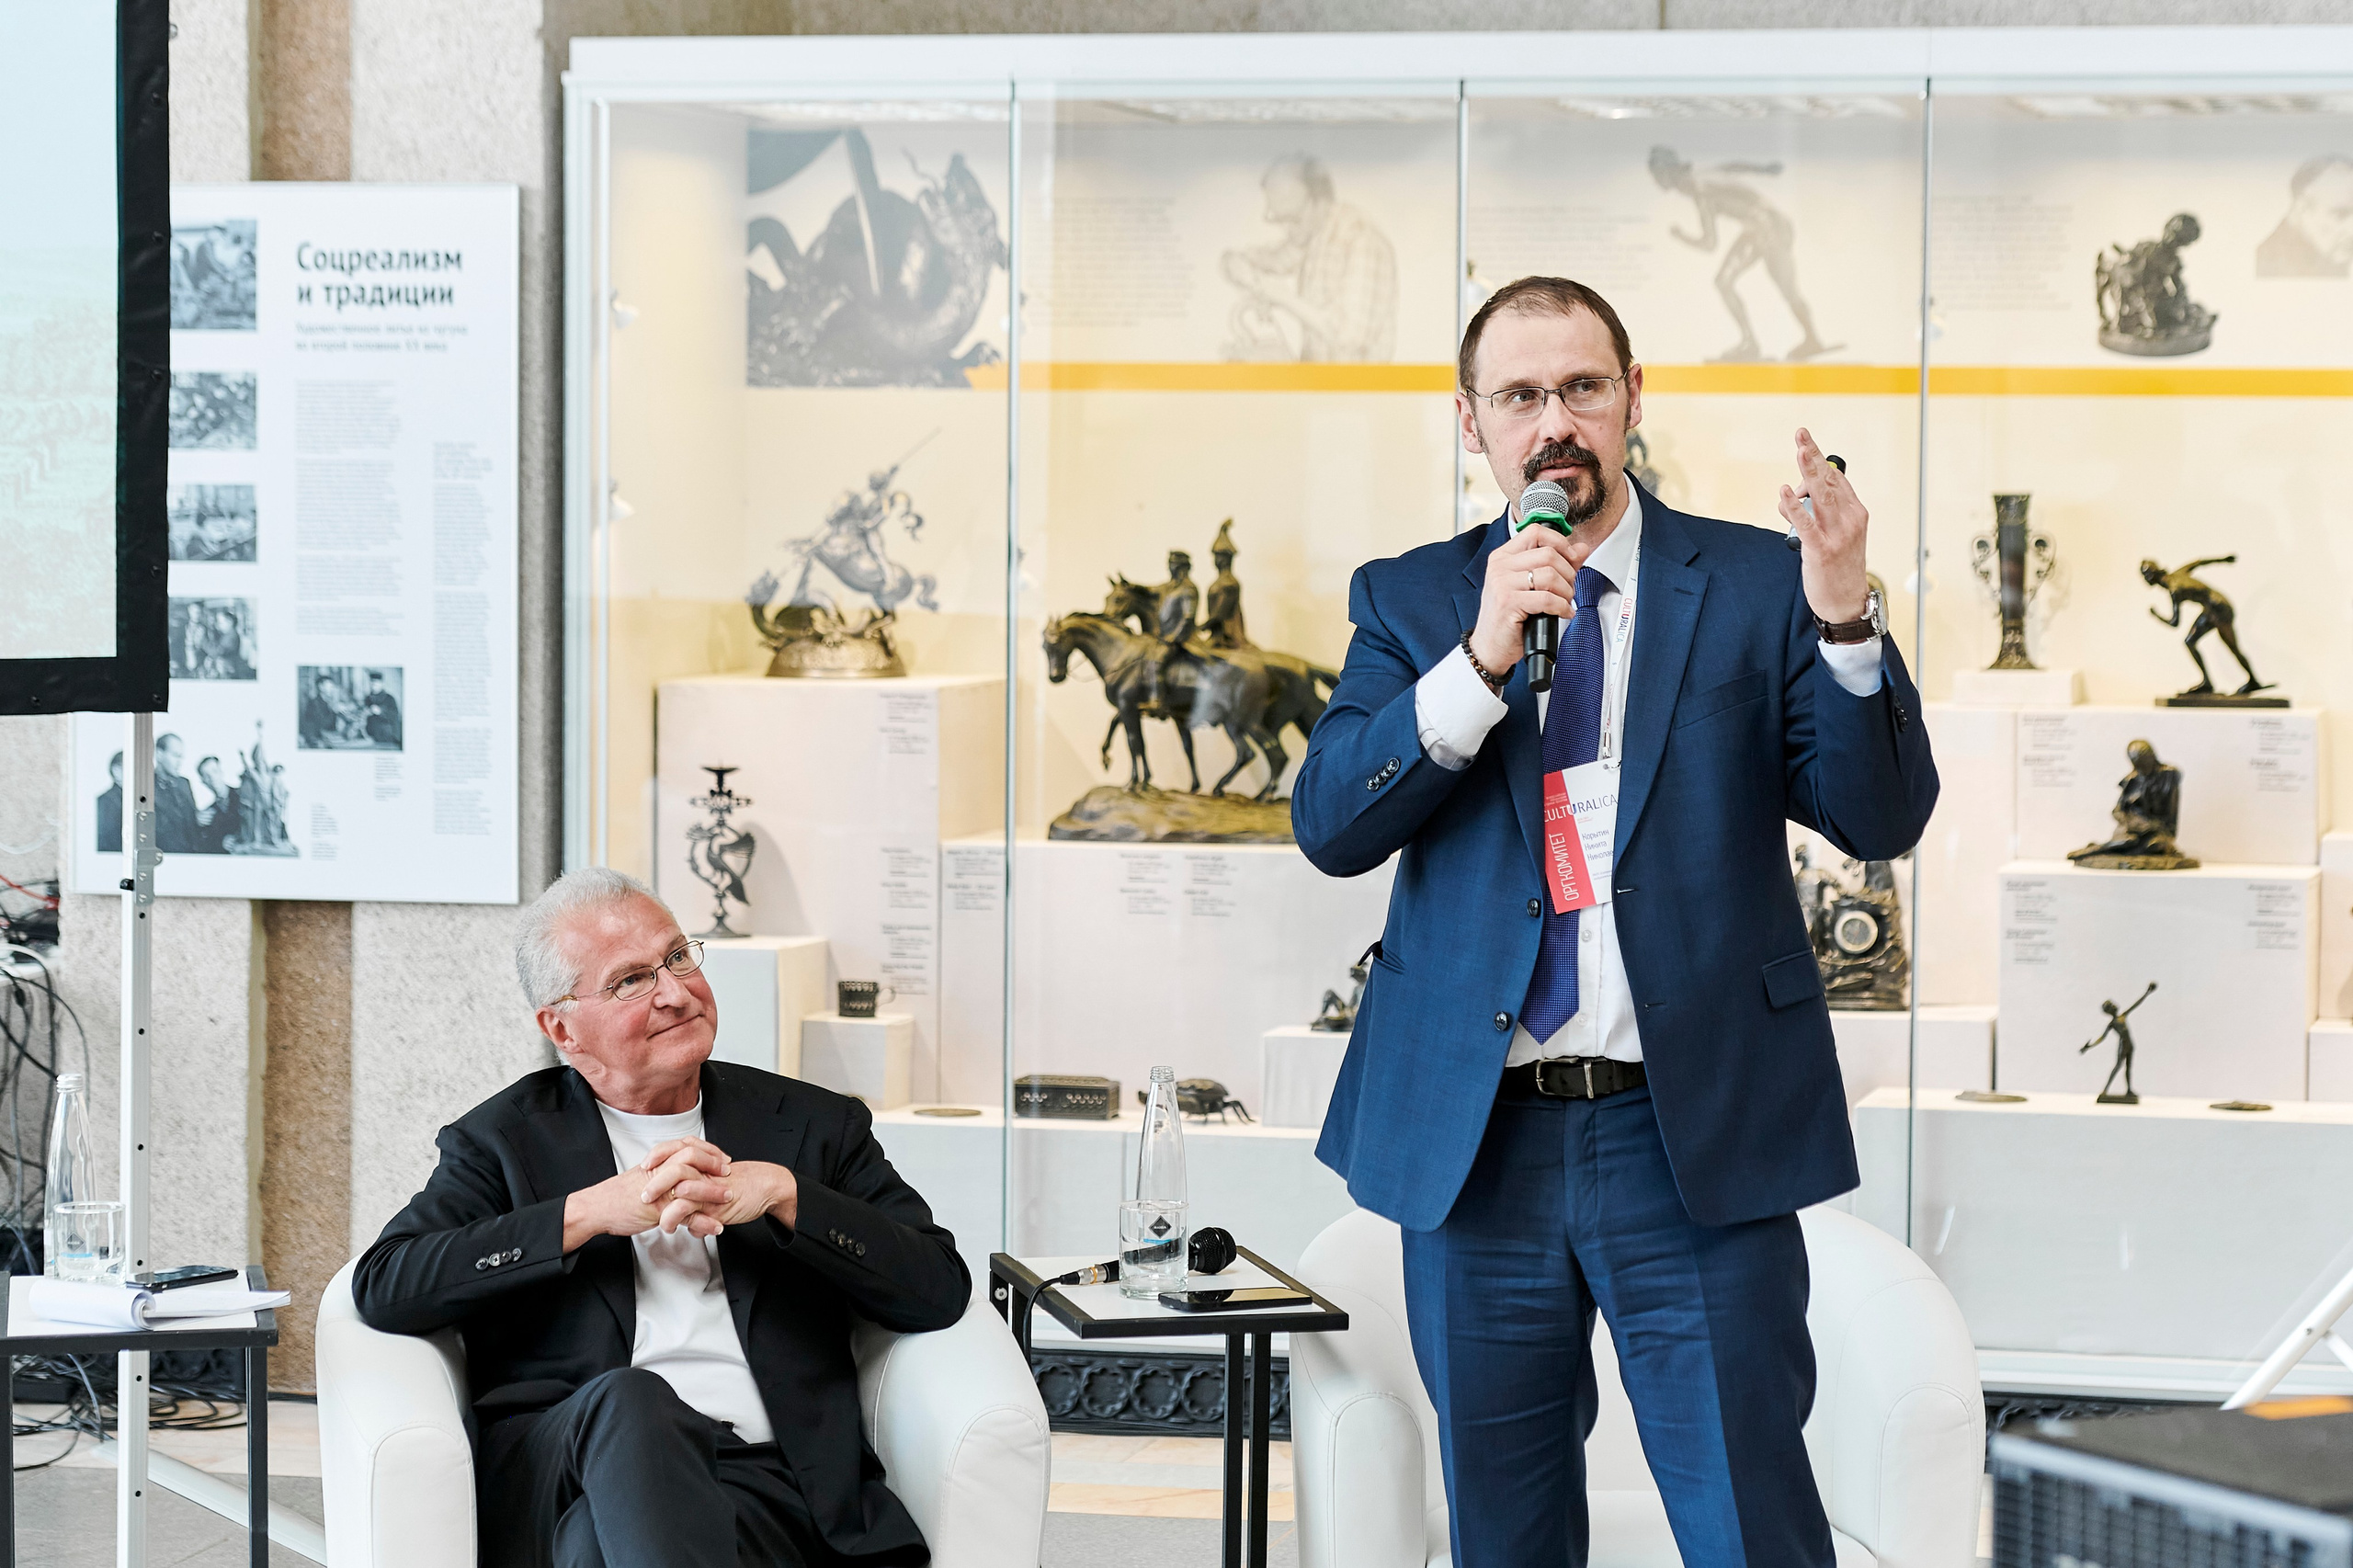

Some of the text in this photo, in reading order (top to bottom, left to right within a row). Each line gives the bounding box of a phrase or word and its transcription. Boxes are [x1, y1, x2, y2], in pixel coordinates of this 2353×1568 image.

[297, 242, 462, 278] Соцреализм
[297, 285, 454, 312] и традиции
[1616, 597, 1633, 642] CULTURALICA
[1549, 833, 1580, 901] ОРГКОМИТЕТ
